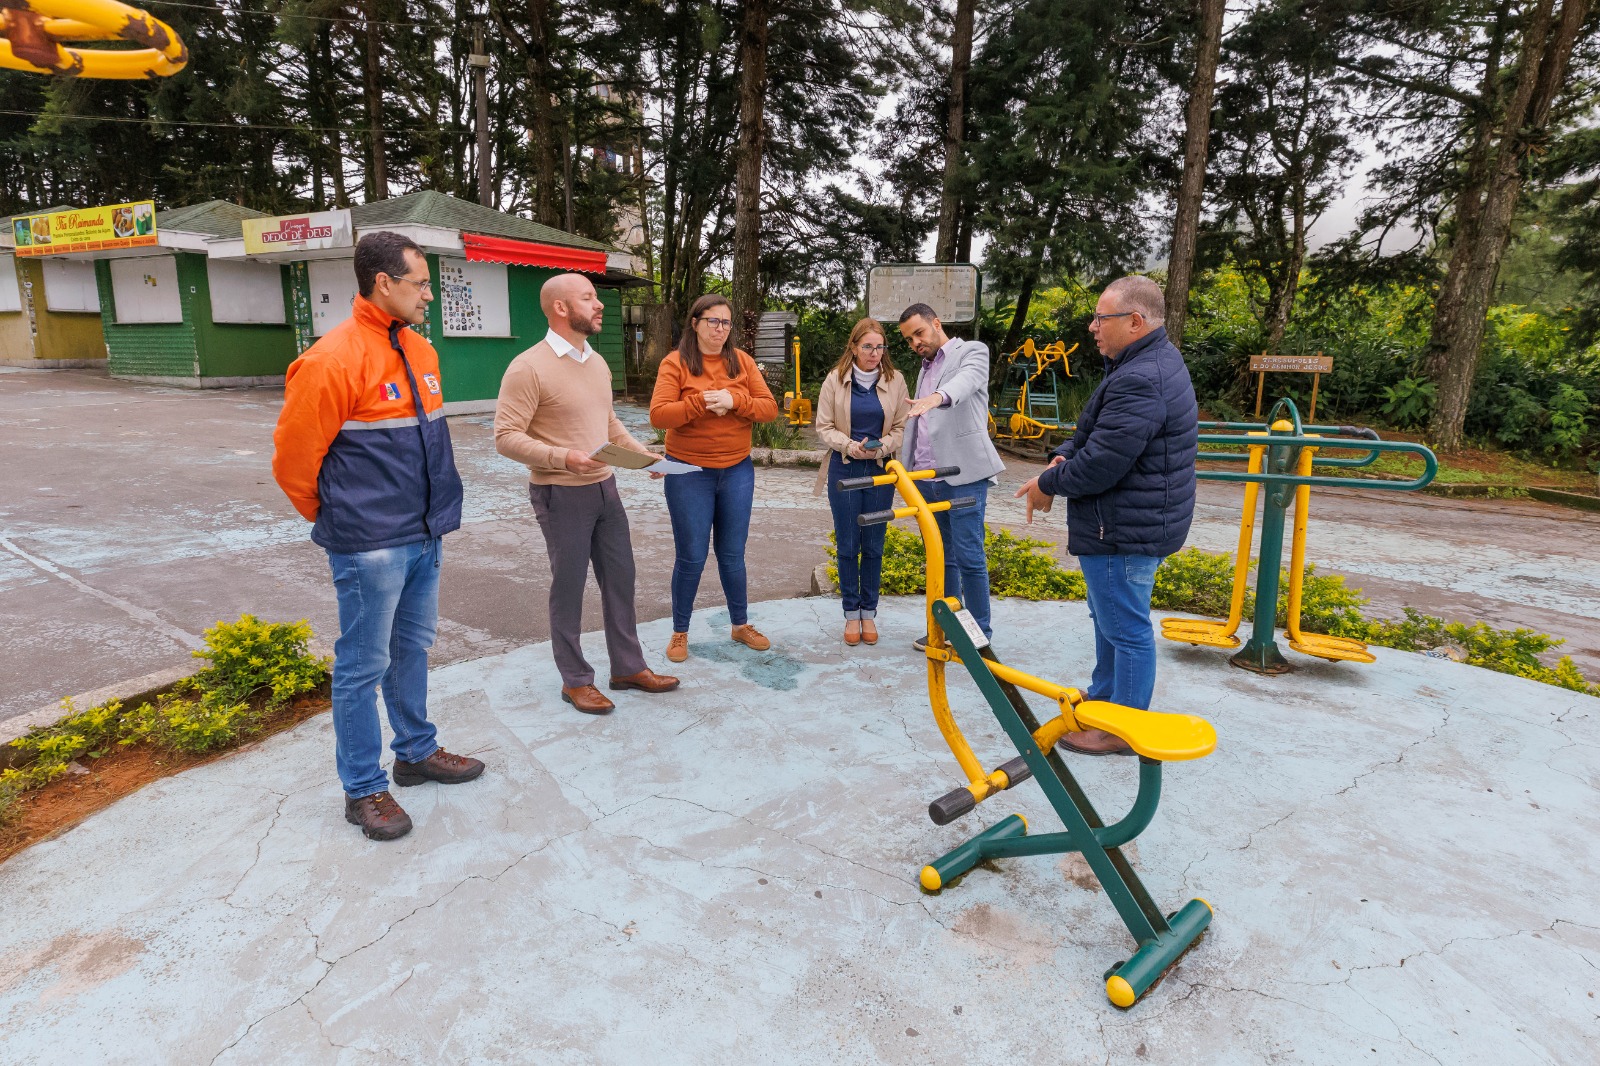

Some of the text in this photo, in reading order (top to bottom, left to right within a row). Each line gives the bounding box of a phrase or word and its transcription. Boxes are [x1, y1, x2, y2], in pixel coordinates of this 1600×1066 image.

[55, 213, 104, 230] Tia Raimunda
[263, 227, 331, 243] DEDO DE DEUS
